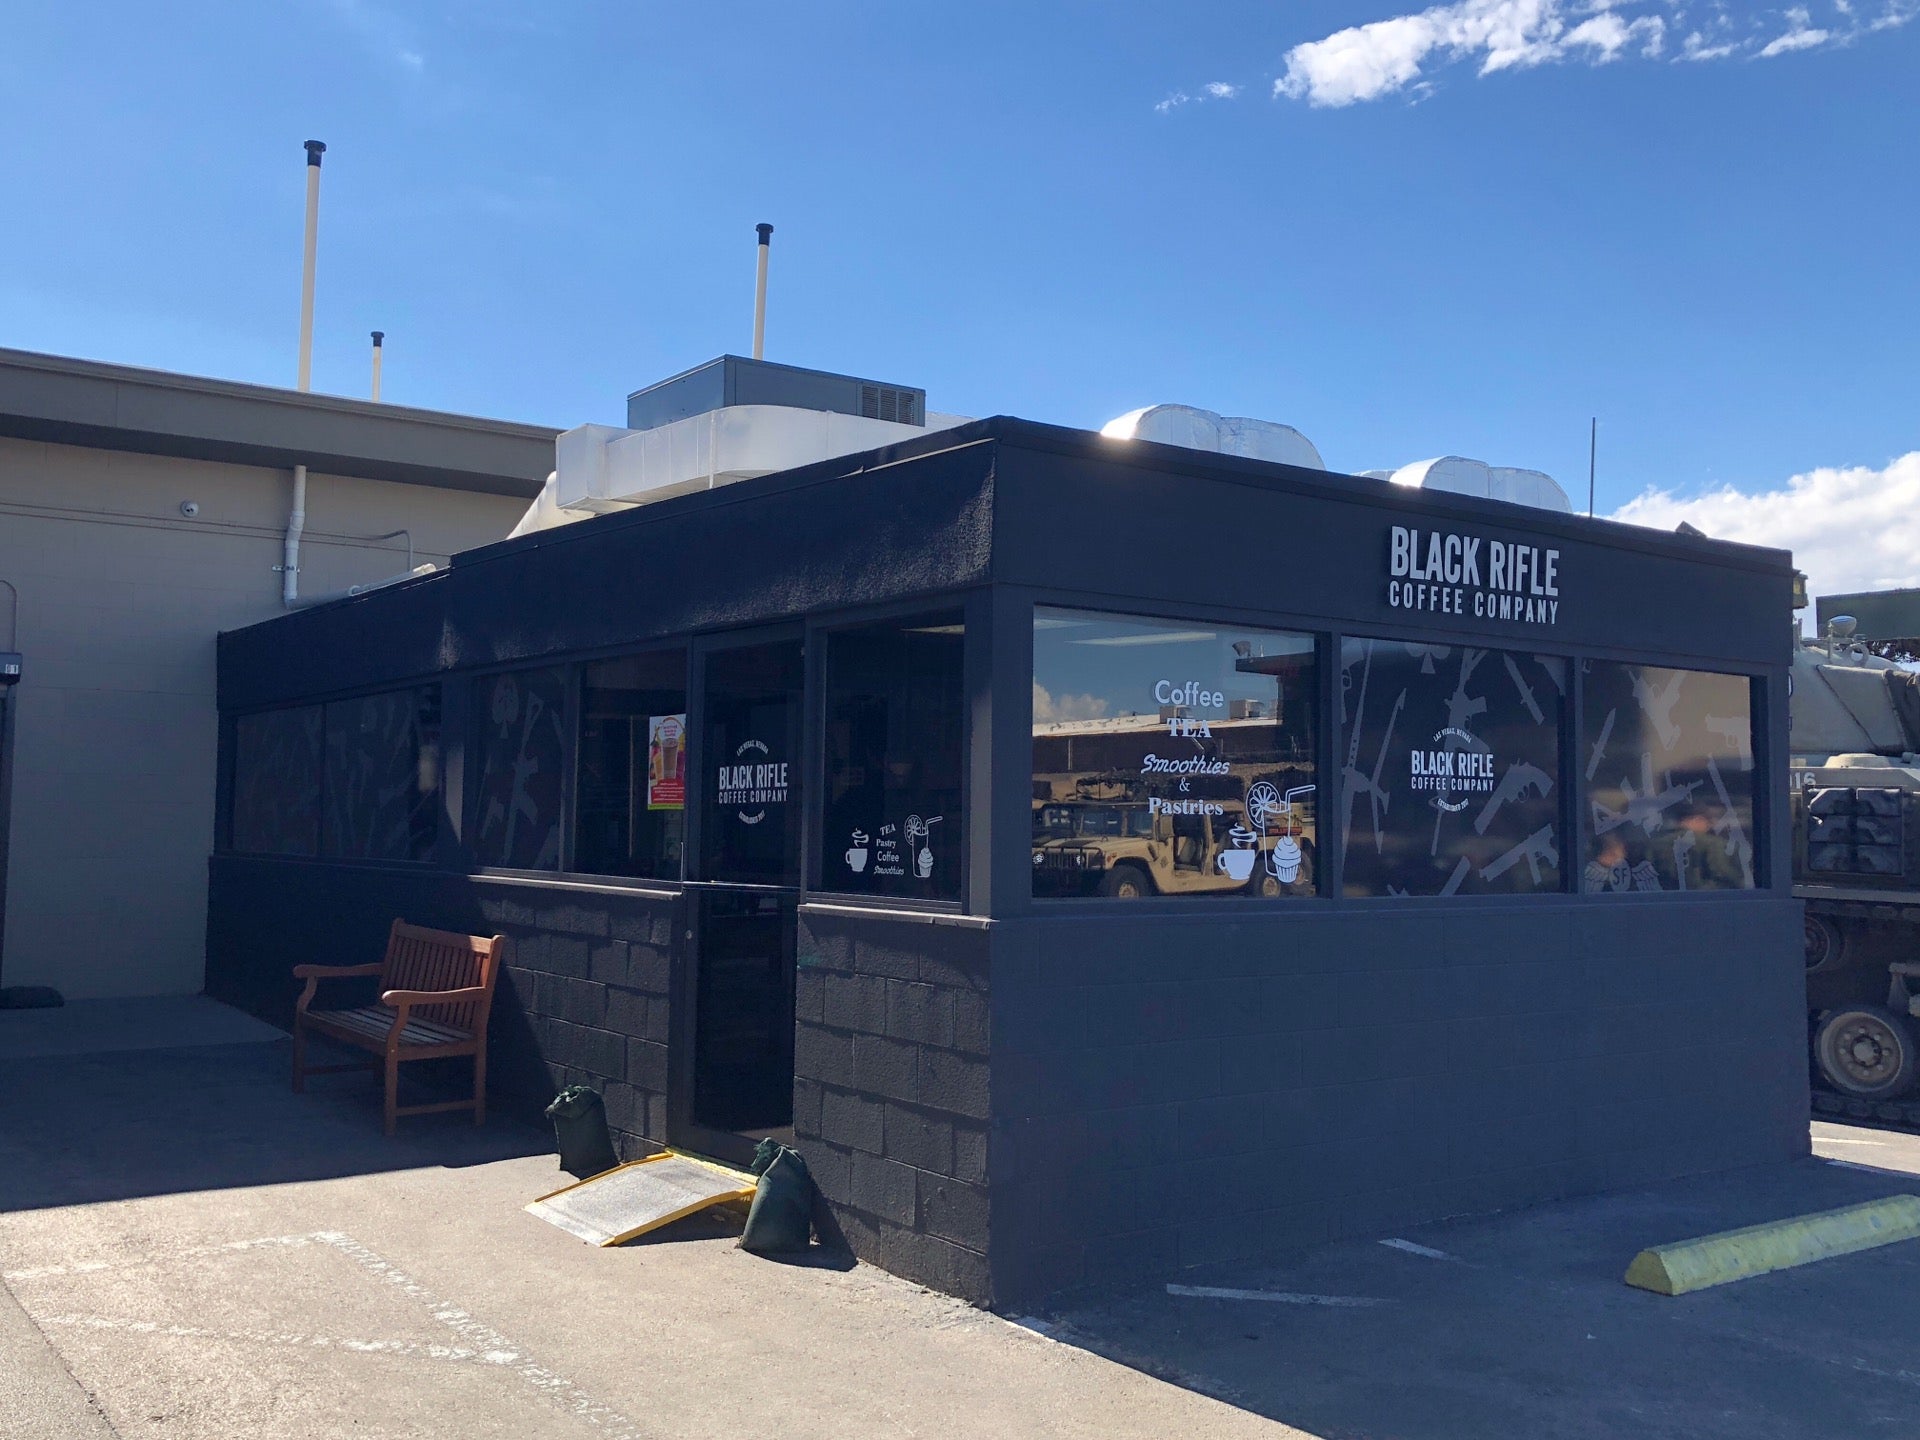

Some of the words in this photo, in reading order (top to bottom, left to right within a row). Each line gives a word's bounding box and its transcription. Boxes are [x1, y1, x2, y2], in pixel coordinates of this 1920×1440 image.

[1391, 526, 1480, 586] BLACK
[1489, 540, 1560, 597] RIFLE
[1389, 580, 1464, 614] COFFEE
[1474, 591, 1559, 624] COMPANY
[1154, 679, 1224, 707] Coffee
[1166, 717, 1213, 738] TEA
[1141, 753, 1231, 775] Smoothies
[1411, 750, 1454, 776] BLACK
[1458, 752, 1494, 777] RIFLE
[719, 765, 753, 790] BLACK
[756, 762, 788, 788] RIFLE
[1179, 776, 1191, 792] &
[1411, 776, 1447, 790] COFFEE
[1451, 778, 1494, 791] COMPANY
[718, 790, 747, 804] COFFEE
[750, 789, 788, 803] COMPANY
[1148, 796, 1224, 815] Pastries
[879, 823, 897, 836] TEA
[876, 838, 897, 849] Pastry
[877, 850, 900, 862] Coffee
[873, 865, 905, 875] Smoothies
[1613, 867, 1628, 885] SF
